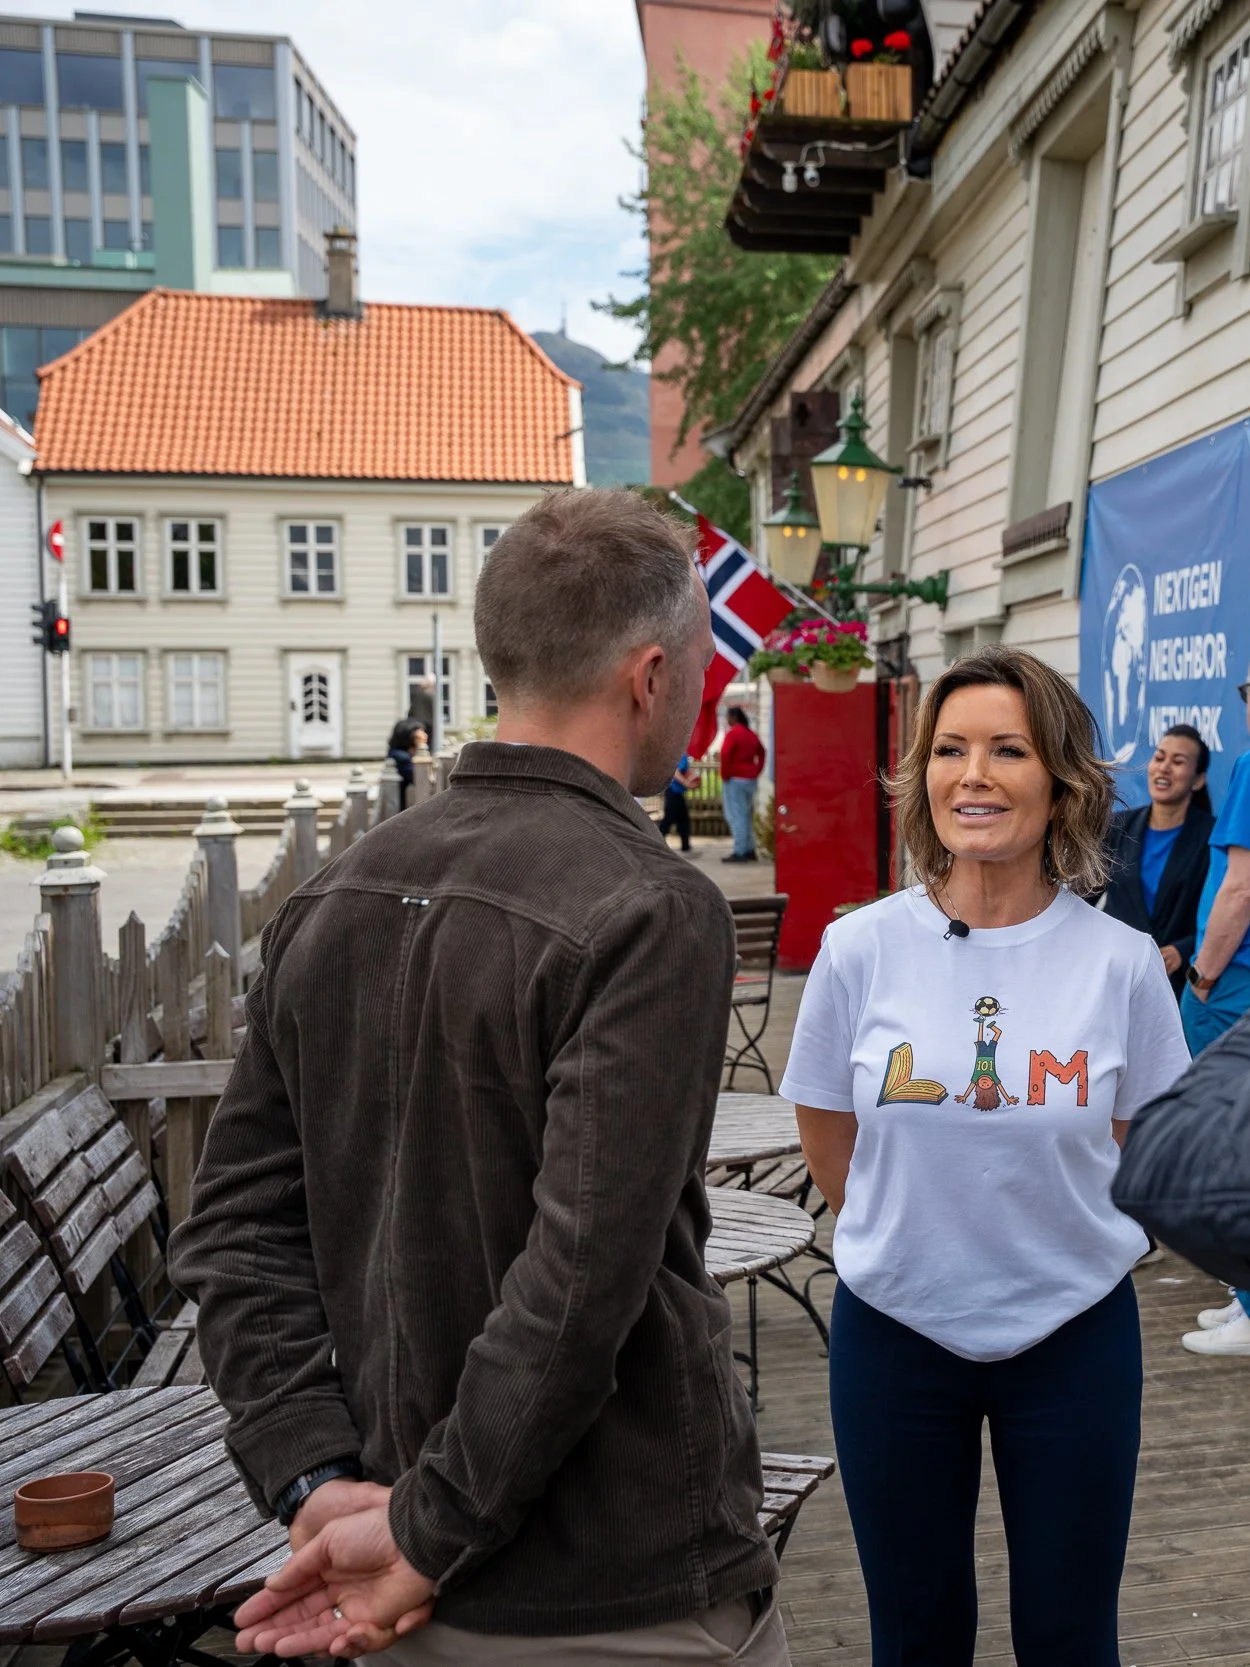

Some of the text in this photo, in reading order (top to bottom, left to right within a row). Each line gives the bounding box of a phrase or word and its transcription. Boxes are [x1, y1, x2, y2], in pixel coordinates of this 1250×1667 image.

[1153, 560, 1222, 615] NEXTGEN
[1149, 632, 1227, 681] NEIGHBOR
[977, 1061, 993, 1071] 101
